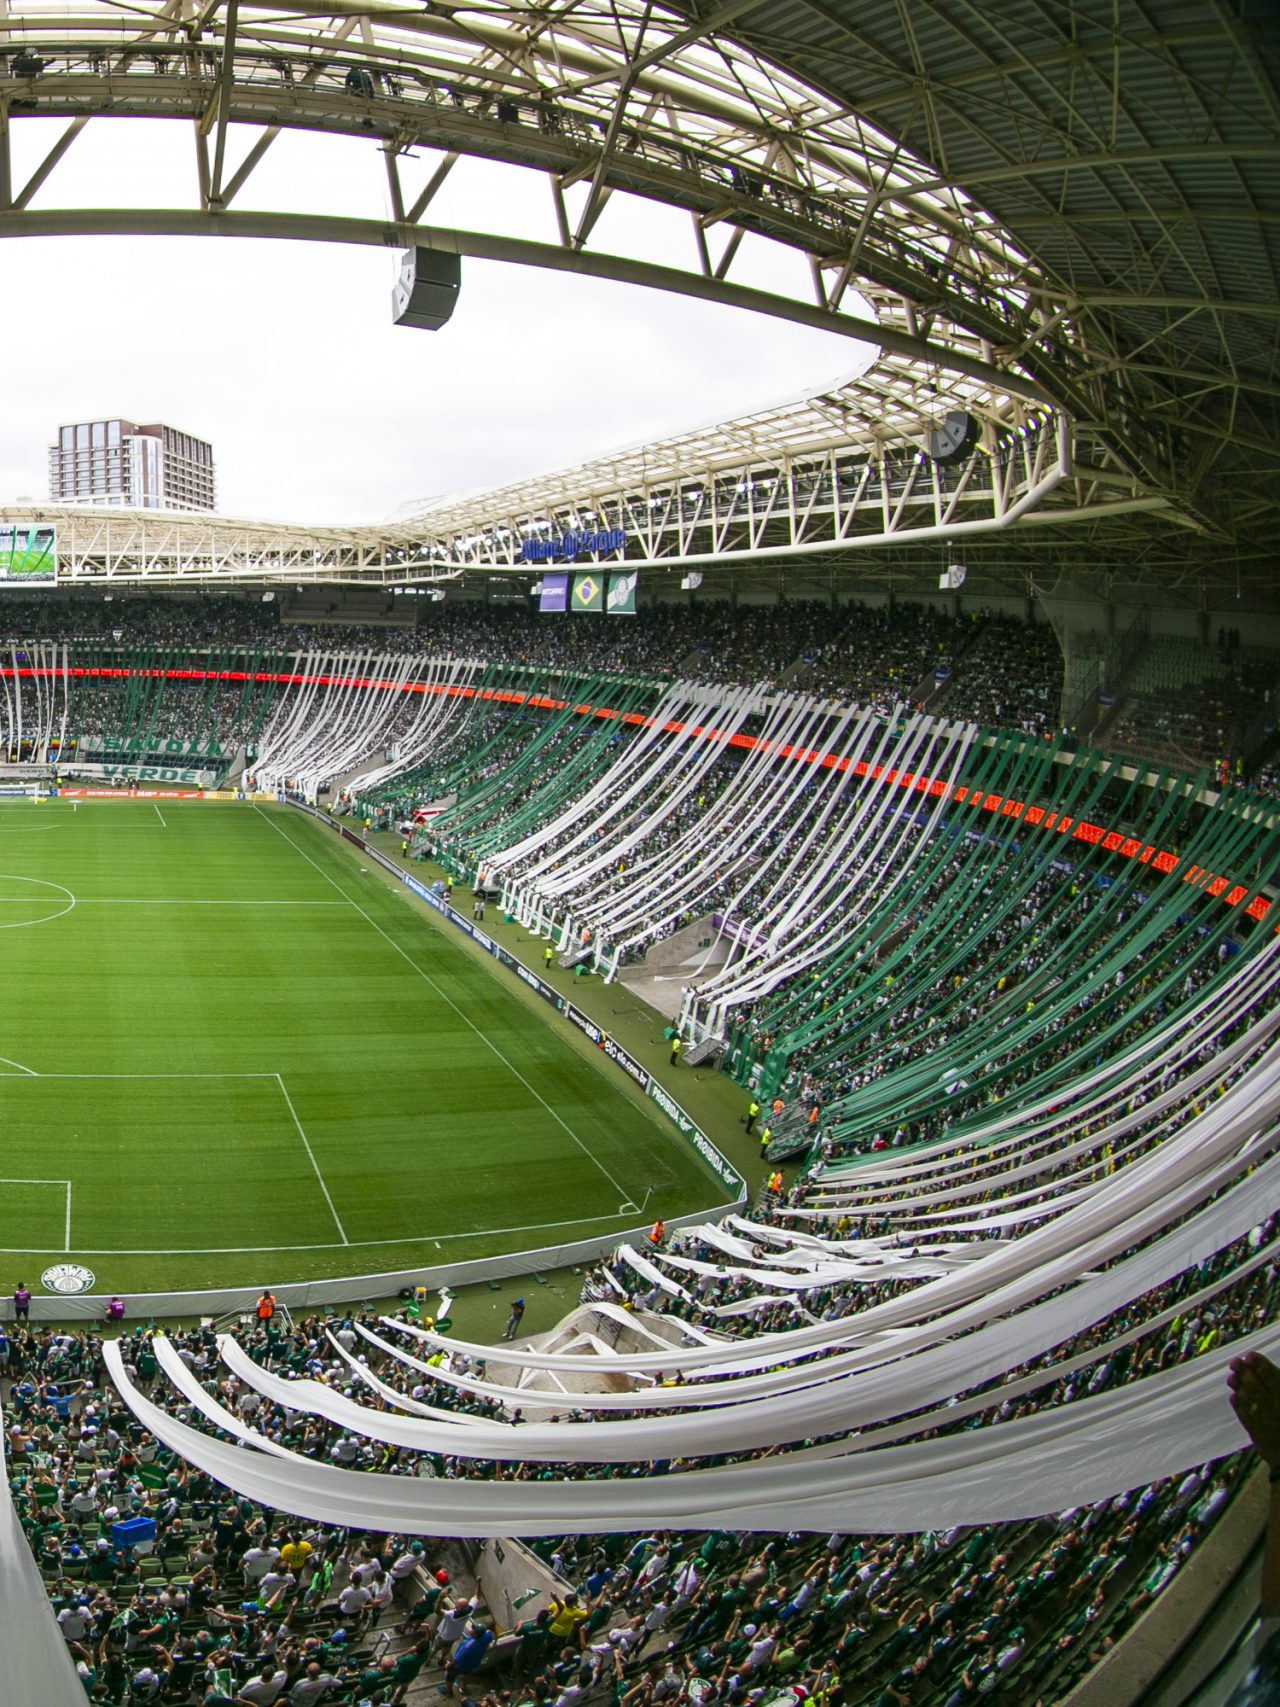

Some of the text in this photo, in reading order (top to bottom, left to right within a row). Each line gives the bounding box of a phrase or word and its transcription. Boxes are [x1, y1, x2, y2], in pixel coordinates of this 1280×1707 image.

[520, 529, 626, 560] Allianz Parque
[103, 765, 198, 782] VERDE
[616, 1050, 648, 1086] elo.com.br
